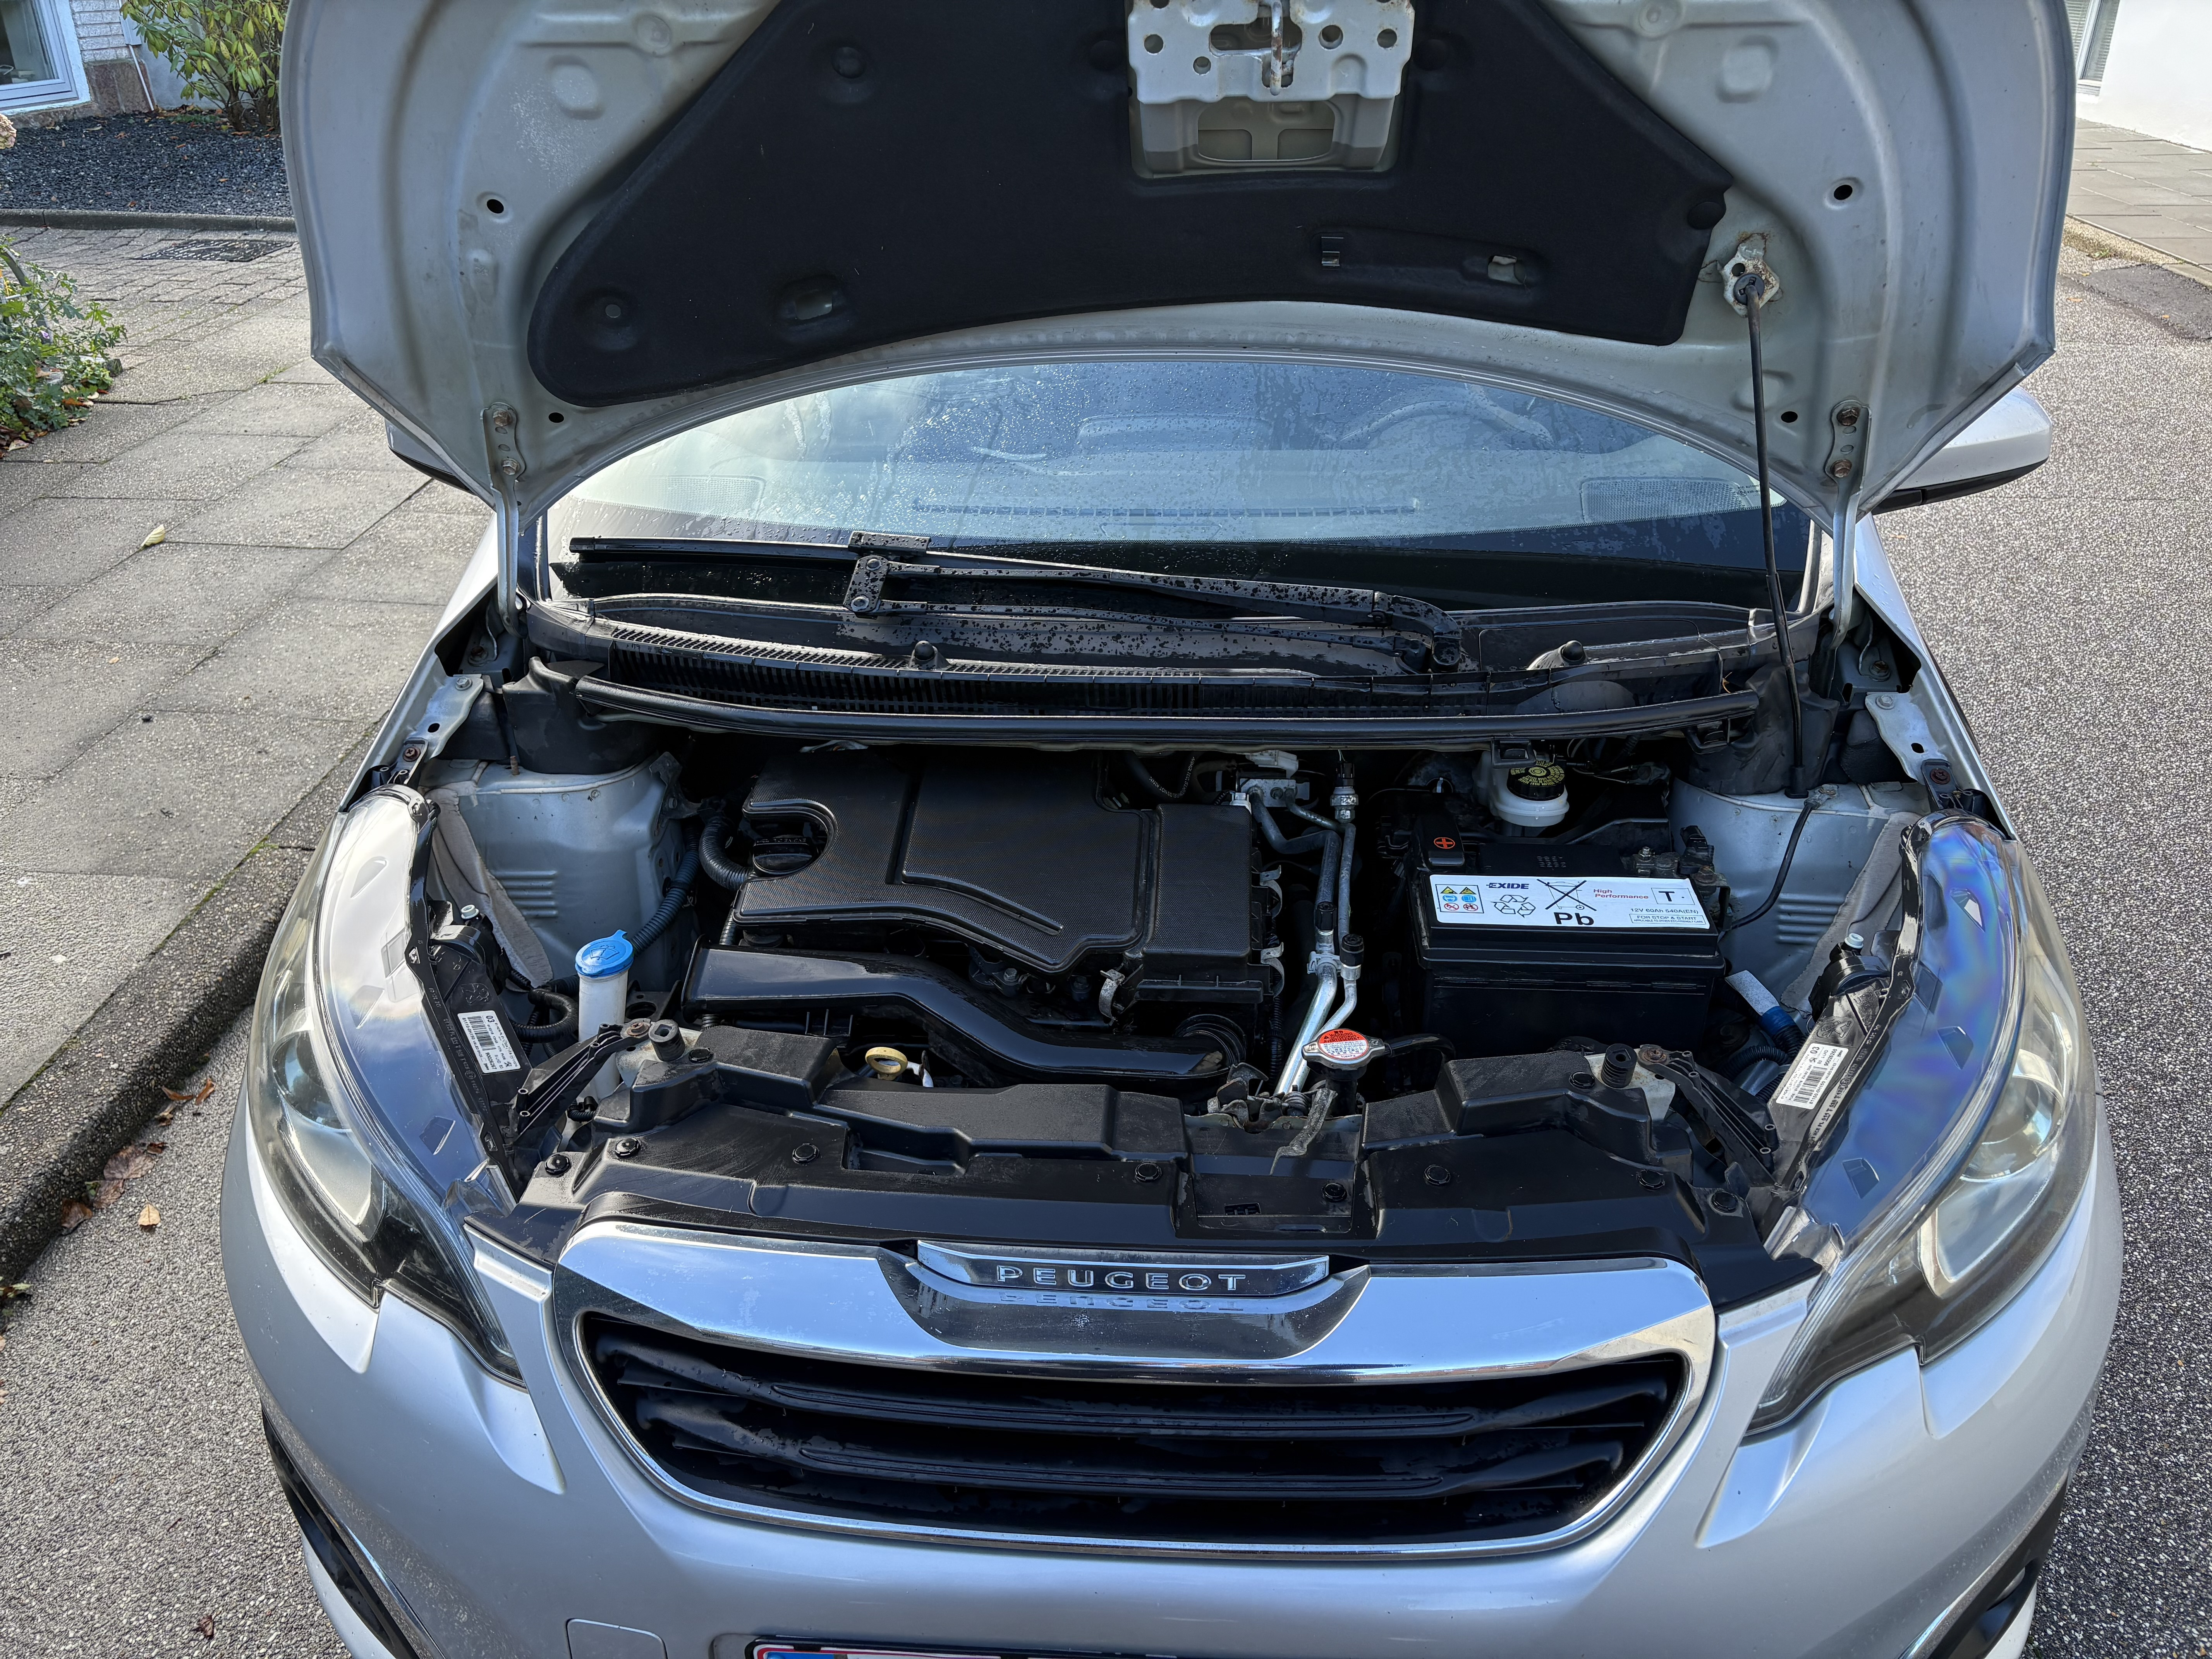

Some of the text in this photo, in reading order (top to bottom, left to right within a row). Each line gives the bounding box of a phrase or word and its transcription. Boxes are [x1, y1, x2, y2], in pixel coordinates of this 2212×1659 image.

[1658, 891, 1675, 902] T
[1554, 912, 1594, 925] Pb
[996, 1265, 1246, 1291] PEUGEOT
